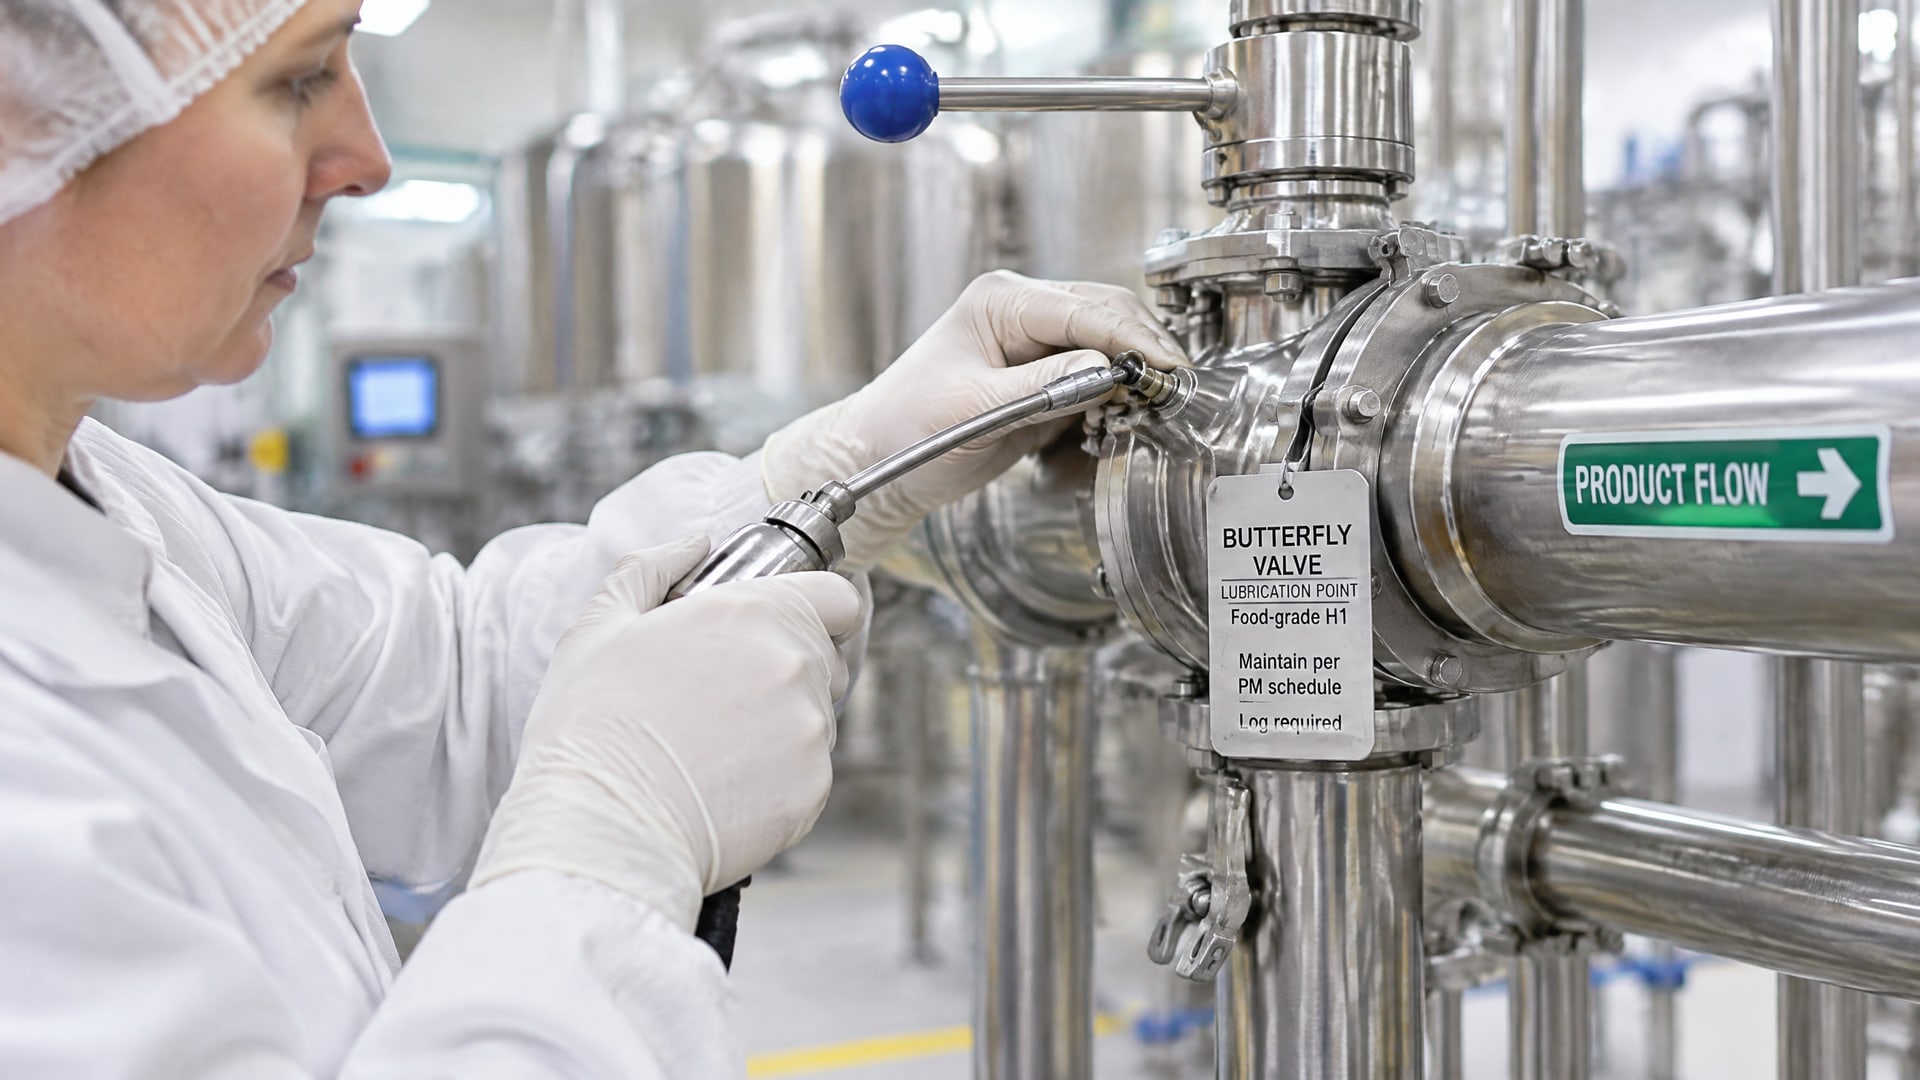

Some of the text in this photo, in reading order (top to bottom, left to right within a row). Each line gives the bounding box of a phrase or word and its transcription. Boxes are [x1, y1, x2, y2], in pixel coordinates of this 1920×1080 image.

[1575, 462, 1770, 506] PRODUCT FLOW
[1223, 524, 1352, 549] BUTTERFLY
[1253, 554, 1323, 576] VALVE
[1221, 583, 1358, 600] LUBRICATION POINT
[1231, 607, 1347, 629] Food-grade H1
[1239, 653, 1341, 674] Maintain per
[1238, 677, 1342, 695] PM schedule
[1239, 713, 1342, 735] Log required
